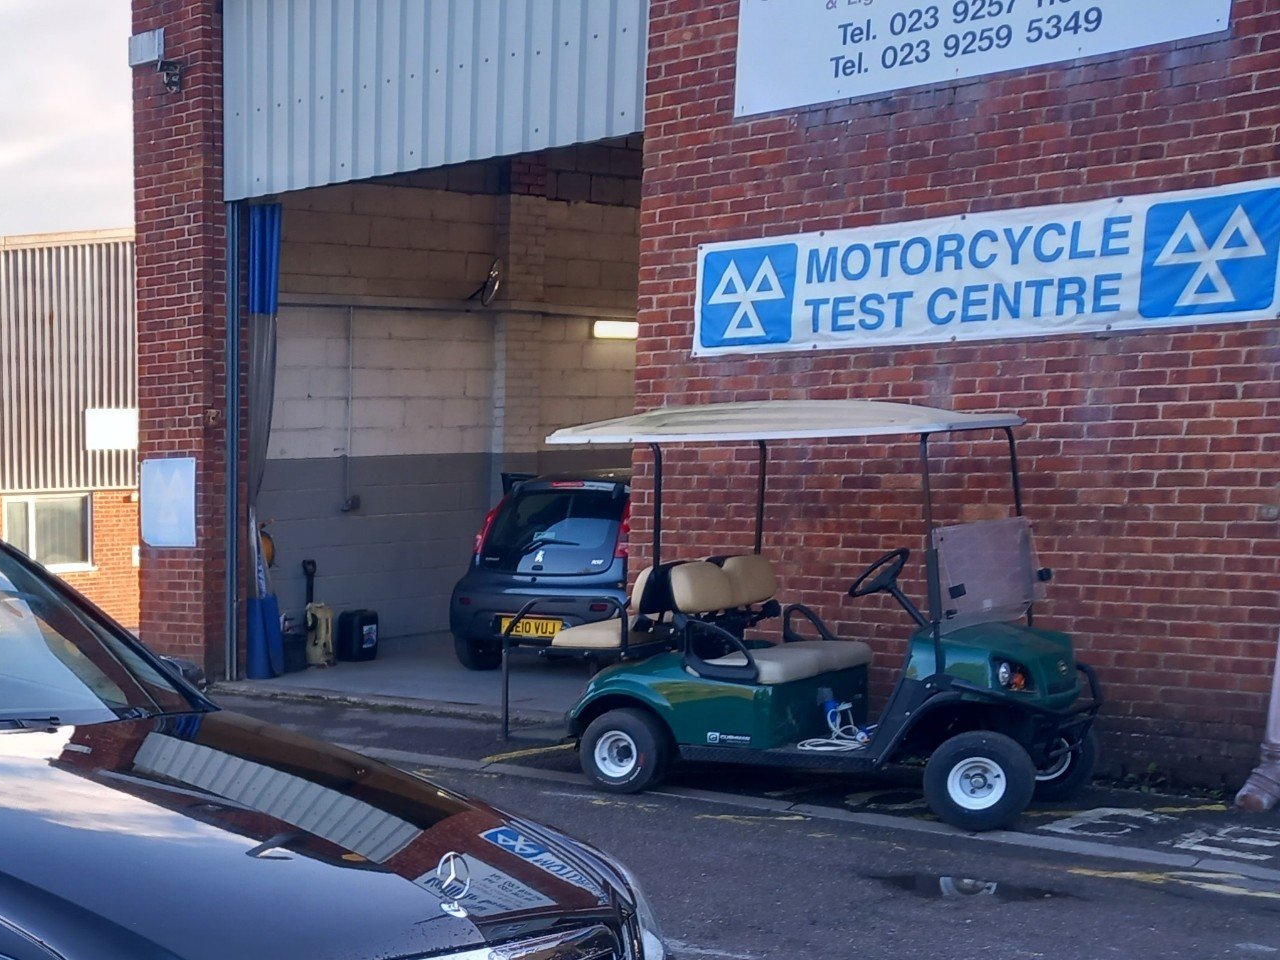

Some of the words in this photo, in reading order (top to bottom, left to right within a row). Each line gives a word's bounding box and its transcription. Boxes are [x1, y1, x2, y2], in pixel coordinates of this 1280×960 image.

[829, 52, 869, 79] Tel.
[880, 39, 931, 69] 023
[943, 24, 1012, 58] 9259
[1025, 6, 1103, 43] 5349
[838, 19, 877, 46] Tel.
[889, 6, 940, 36] 023
[804, 214, 1133, 285] MOTORCYCLE
[804, 290, 913, 334] TEST
[926, 272, 1124, 327] CENTRE
[509, 620, 532, 634] E10
[534, 621, 556, 635] VUJ
